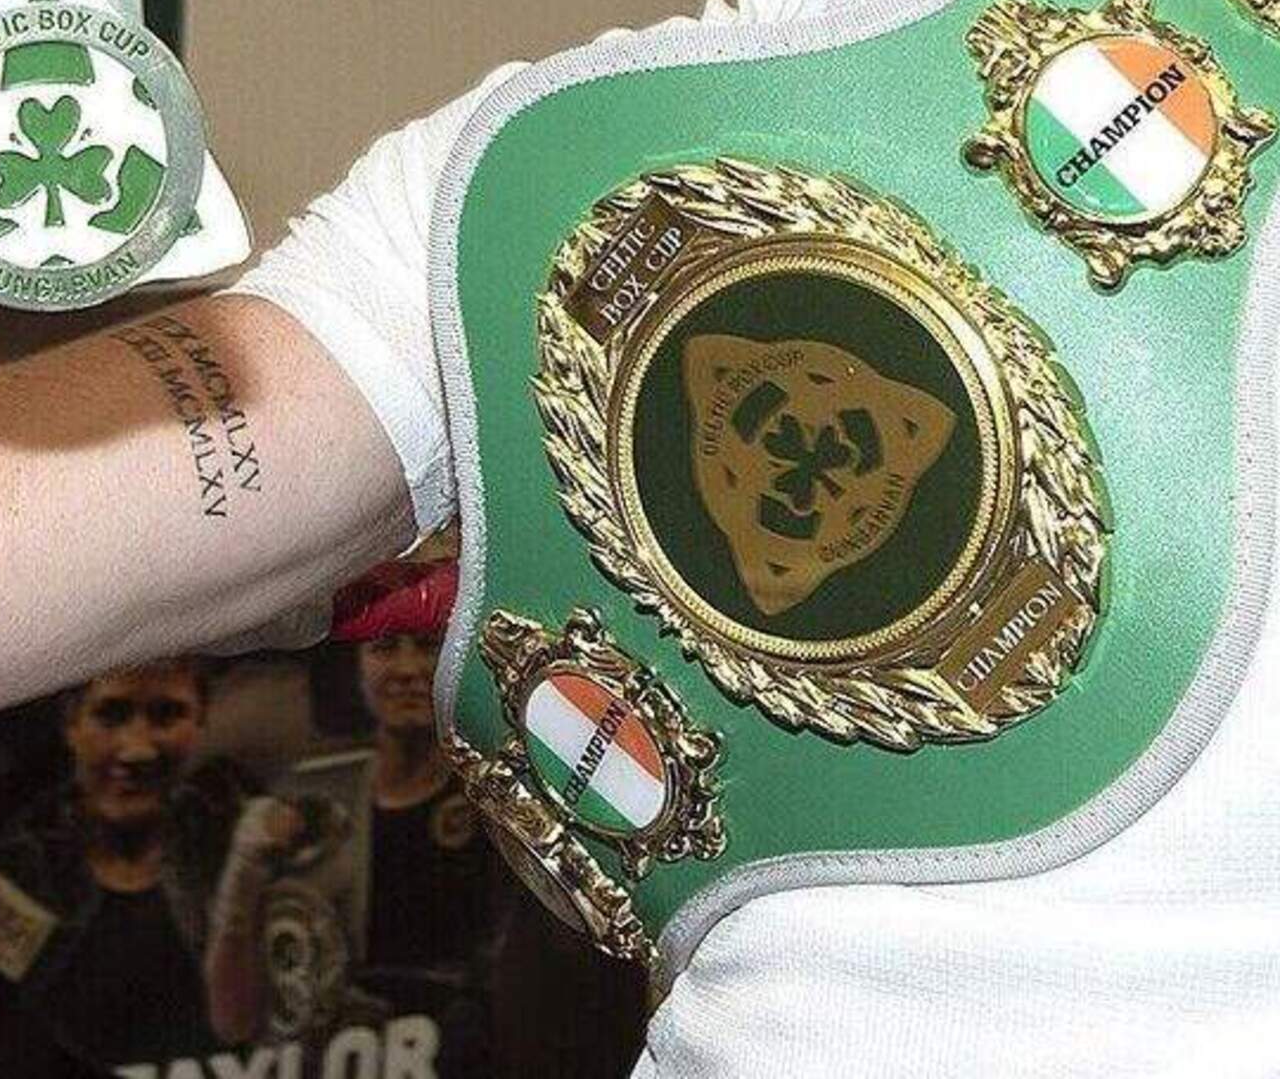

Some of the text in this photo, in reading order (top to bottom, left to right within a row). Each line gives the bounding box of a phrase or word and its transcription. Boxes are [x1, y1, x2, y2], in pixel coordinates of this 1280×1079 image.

[38, 9, 94, 35] BOX
[98, 20, 151, 60] CUP
[1055, 61, 1187, 189] CHAMPION
[590, 218, 657, 293] CELTIC
[600, 227, 684, 327] BOX CUP
[955, 578, 1064, 695] CHAMPION
[564, 699, 629, 808] CHAMPION
